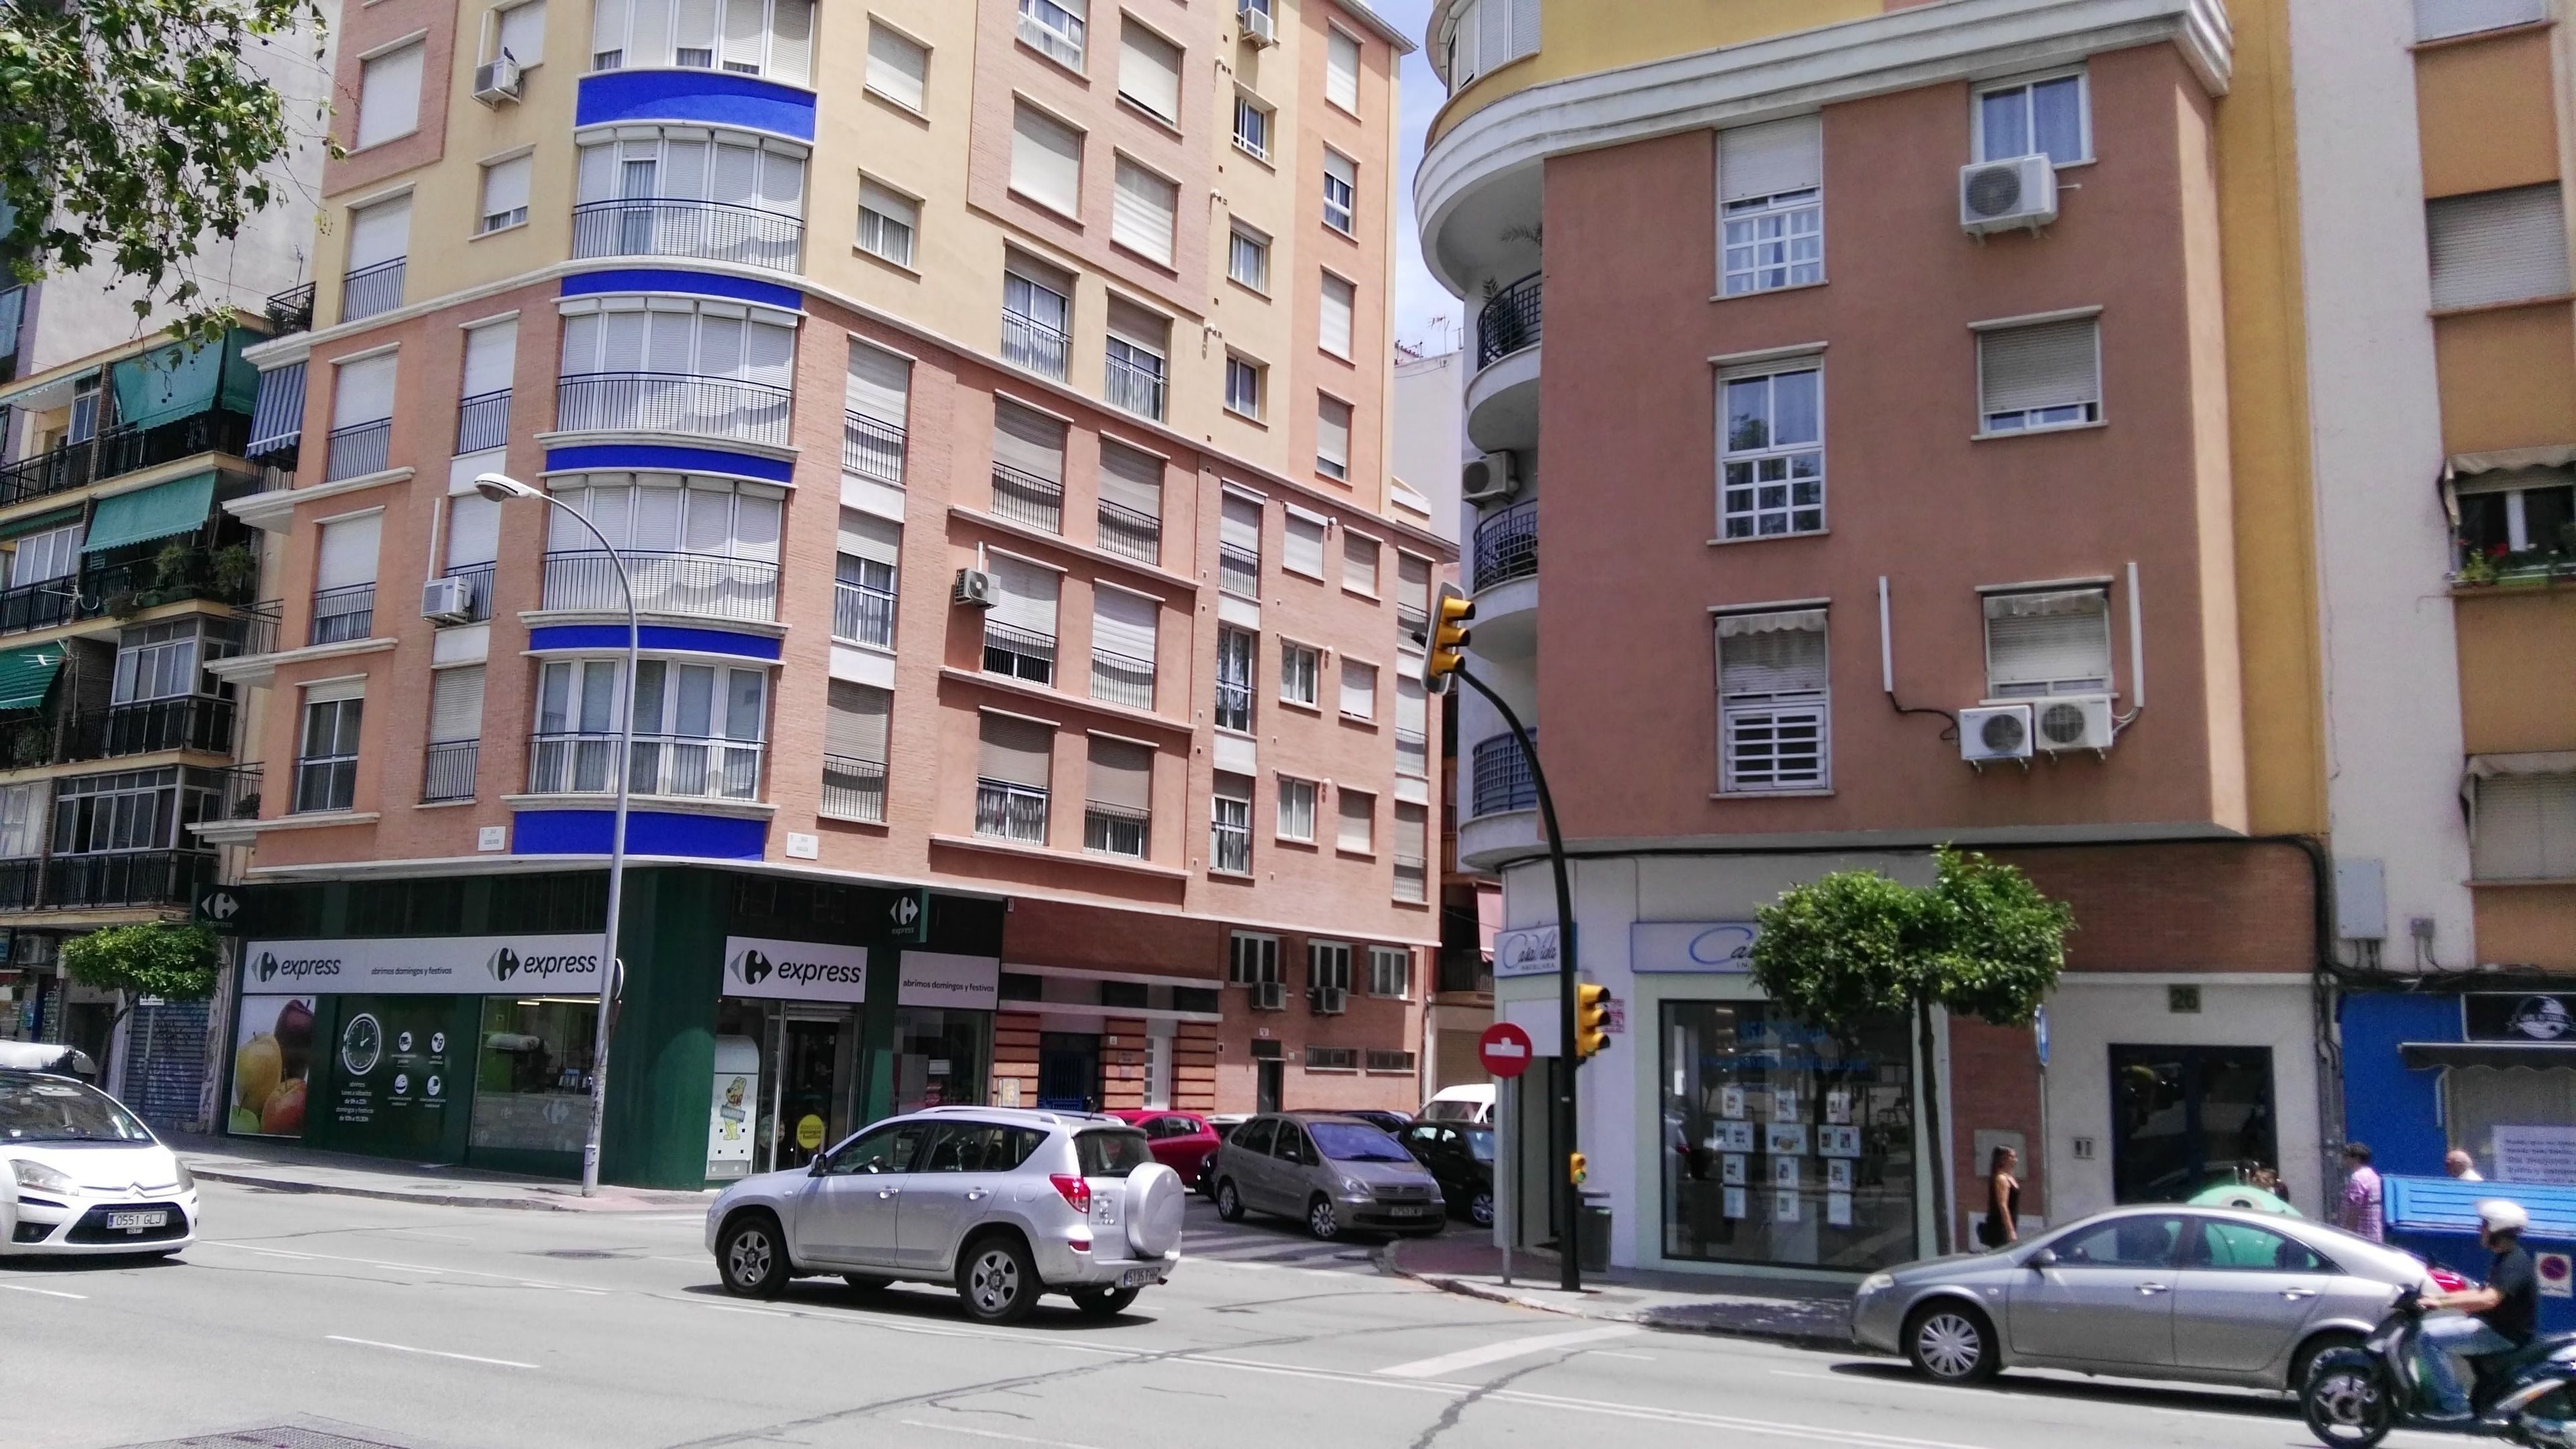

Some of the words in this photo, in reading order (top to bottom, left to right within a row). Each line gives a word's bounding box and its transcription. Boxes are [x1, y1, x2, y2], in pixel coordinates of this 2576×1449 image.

[892, 927, 914, 936] express
[281, 959, 341, 980] express
[395, 967, 423, 976] domingos
[429, 966, 452, 974] festivos
[524, 955, 597, 979] express
[778, 962, 861, 985] express
[903, 979, 930, 988] abrimos
[932, 981, 963, 991] domingos
[965, 983, 969, 992] y
[969, 983, 994, 991] festivos
[116, 1215, 139, 1226] 0551
[144, 1214, 162, 1224] GLJ
